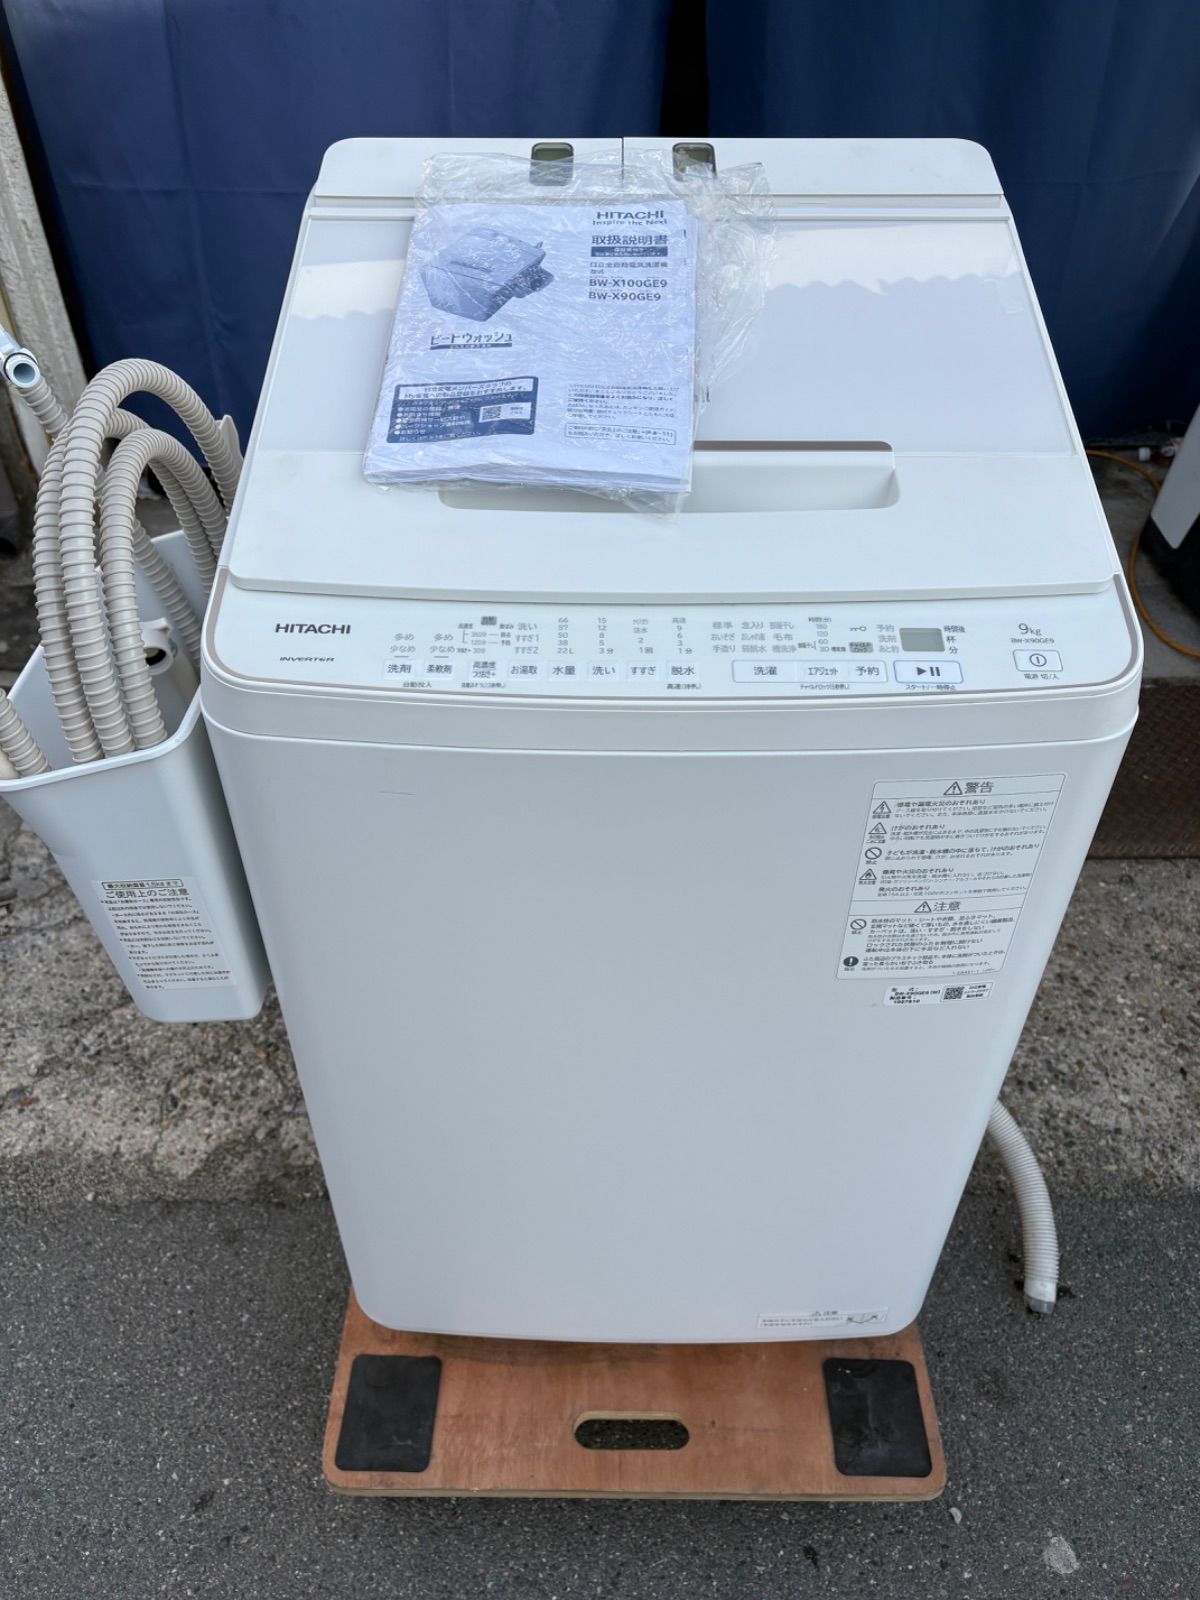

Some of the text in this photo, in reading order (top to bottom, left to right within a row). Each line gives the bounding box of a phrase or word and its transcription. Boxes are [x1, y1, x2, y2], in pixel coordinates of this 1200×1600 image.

[597, 210, 664, 219] HITACHI
[592, 234, 669, 245] 取扱説明書
[589, 279, 668, 288] BW-X100GE9
[588, 291, 661, 301] BW-X90GE9
[430, 332, 512, 345] ビートウォッシュ
[275, 623, 351, 634] HITACHI
[1018, 622, 1042, 636] 9kg
[394, 633, 415, 641] 多め
[434, 633, 453, 641] 多め
[773, 633, 793, 641] 毛布
[946, 636, 957, 644] 杯
[948, 647, 958, 655] 分
[387, 664, 412, 674] 洗剤
[426, 664, 452, 674] 柔軟剤
[511, 666, 538, 675] お湯取
[552, 666, 576, 675] 水量
[592, 666, 616, 675] 洗い
[631, 666, 656, 675] すすぎ
[671, 666, 696, 675] 脱水
[754, 667, 778, 675] 洗濯
[856, 667, 880, 676] 予約
[964, 781, 994, 794] 警告
[106, 888, 189, 898] ご使用上のご注意
[933, 901, 961, 912] 注意
